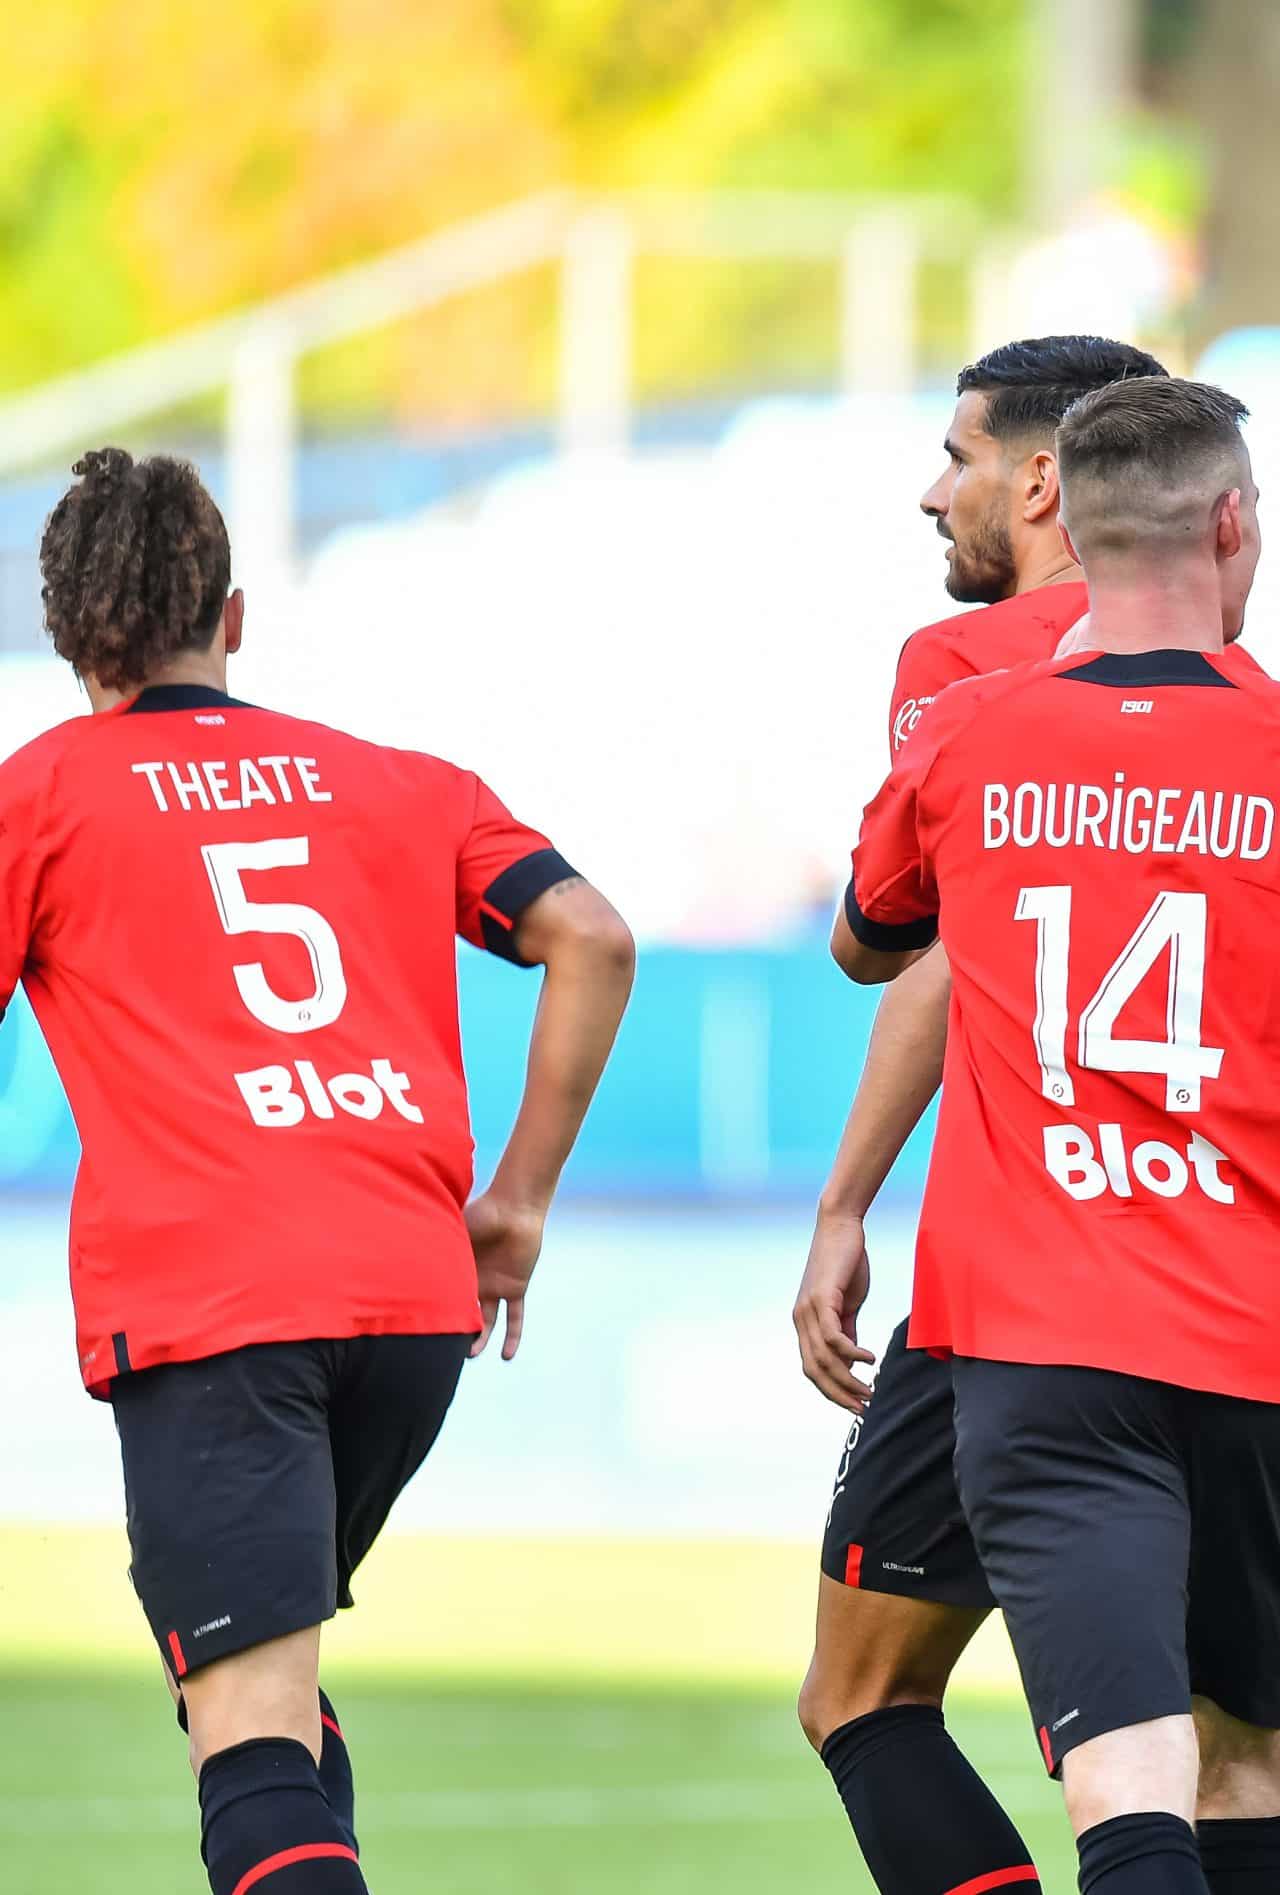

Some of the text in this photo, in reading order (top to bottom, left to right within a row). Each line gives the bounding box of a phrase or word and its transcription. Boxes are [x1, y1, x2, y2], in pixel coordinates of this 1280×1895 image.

[131, 755, 333, 812] THEATE
[200, 836, 348, 1034] 5
[1013, 885, 1225, 1113] 14
[233, 1058, 425, 1128] Blot
[1042, 1123, 1235, 1205] Blot
